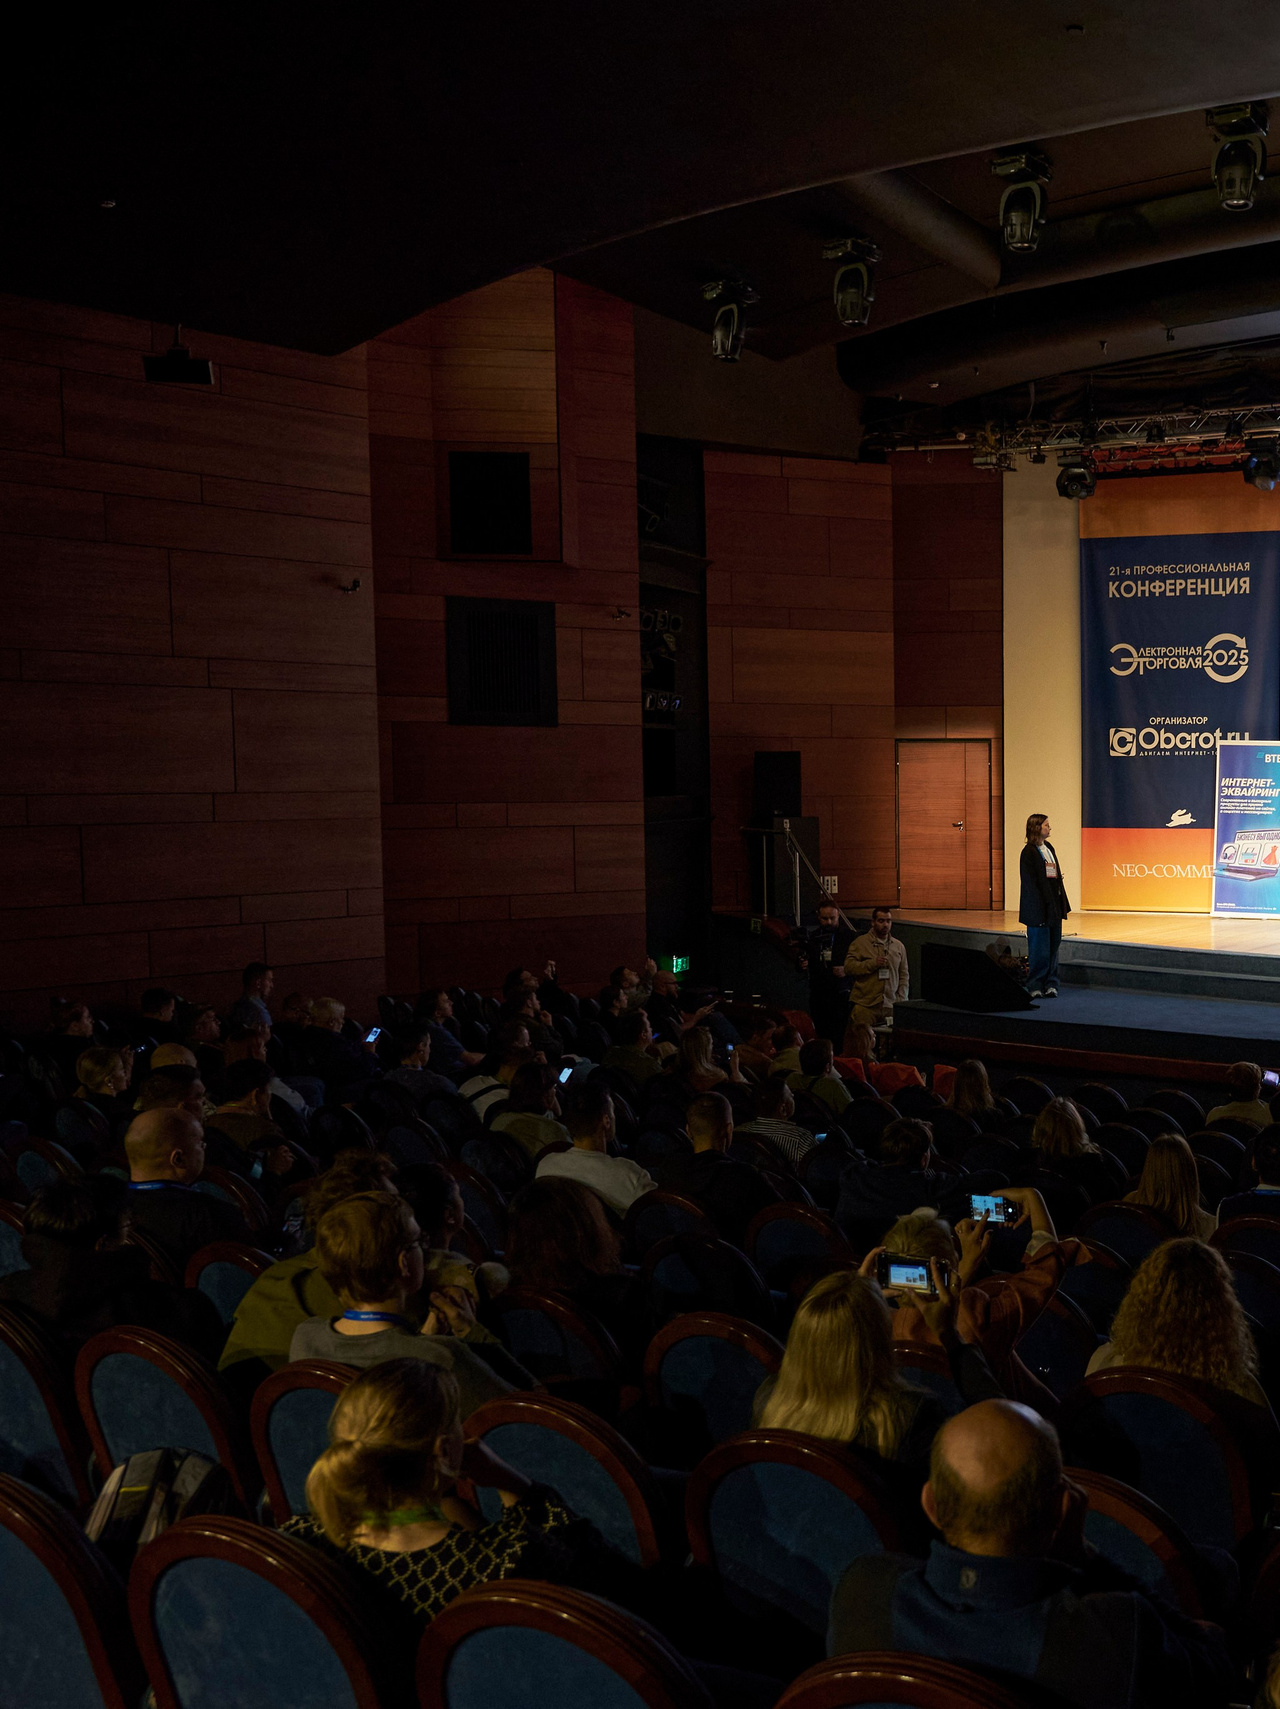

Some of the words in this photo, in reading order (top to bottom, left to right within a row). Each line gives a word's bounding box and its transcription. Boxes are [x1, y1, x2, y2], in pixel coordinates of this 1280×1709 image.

[1109, 566, 1131, 576] 21-я
[1133, 562, 1250, 575] ПРОФЕССИОНАЛЬНАЯ
[1109, 577, 1250, 598] КОНФЕРЕНЦИЯ
[1134, 657, 1202, 675] ТОРГОВЛЯ
[1203, 650, 1249, 666] 2025
[1150, 716, 1208, 725] ОРГАНИЗАТОР
[1220, 777, 1276, 788] ИНТЕРНЕТ-
[1112, 863, 1213, 879] NEO-COMME
